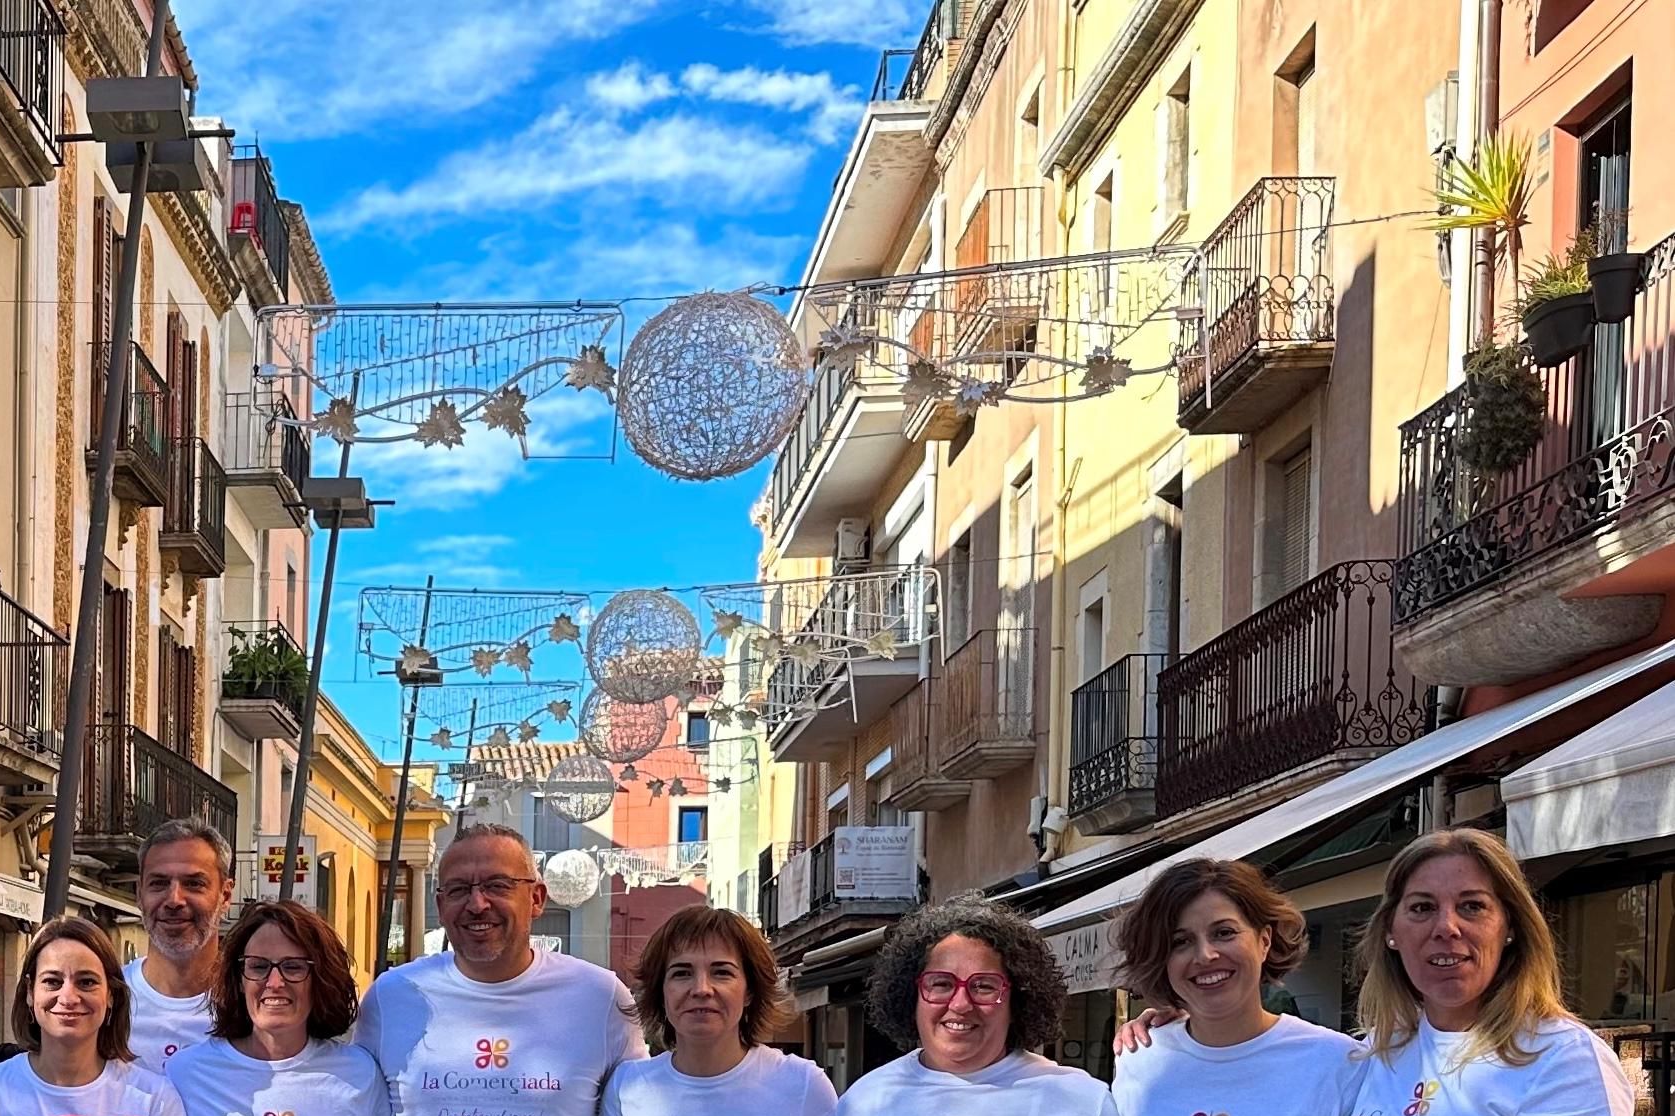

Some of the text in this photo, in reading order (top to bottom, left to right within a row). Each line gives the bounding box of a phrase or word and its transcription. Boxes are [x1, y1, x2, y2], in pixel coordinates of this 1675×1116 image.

[263, 858, 309, 871] Kok
[1065, 928, 1098, 961] CALMA
[421, 1071, 562, 1094] la Comerçiada
